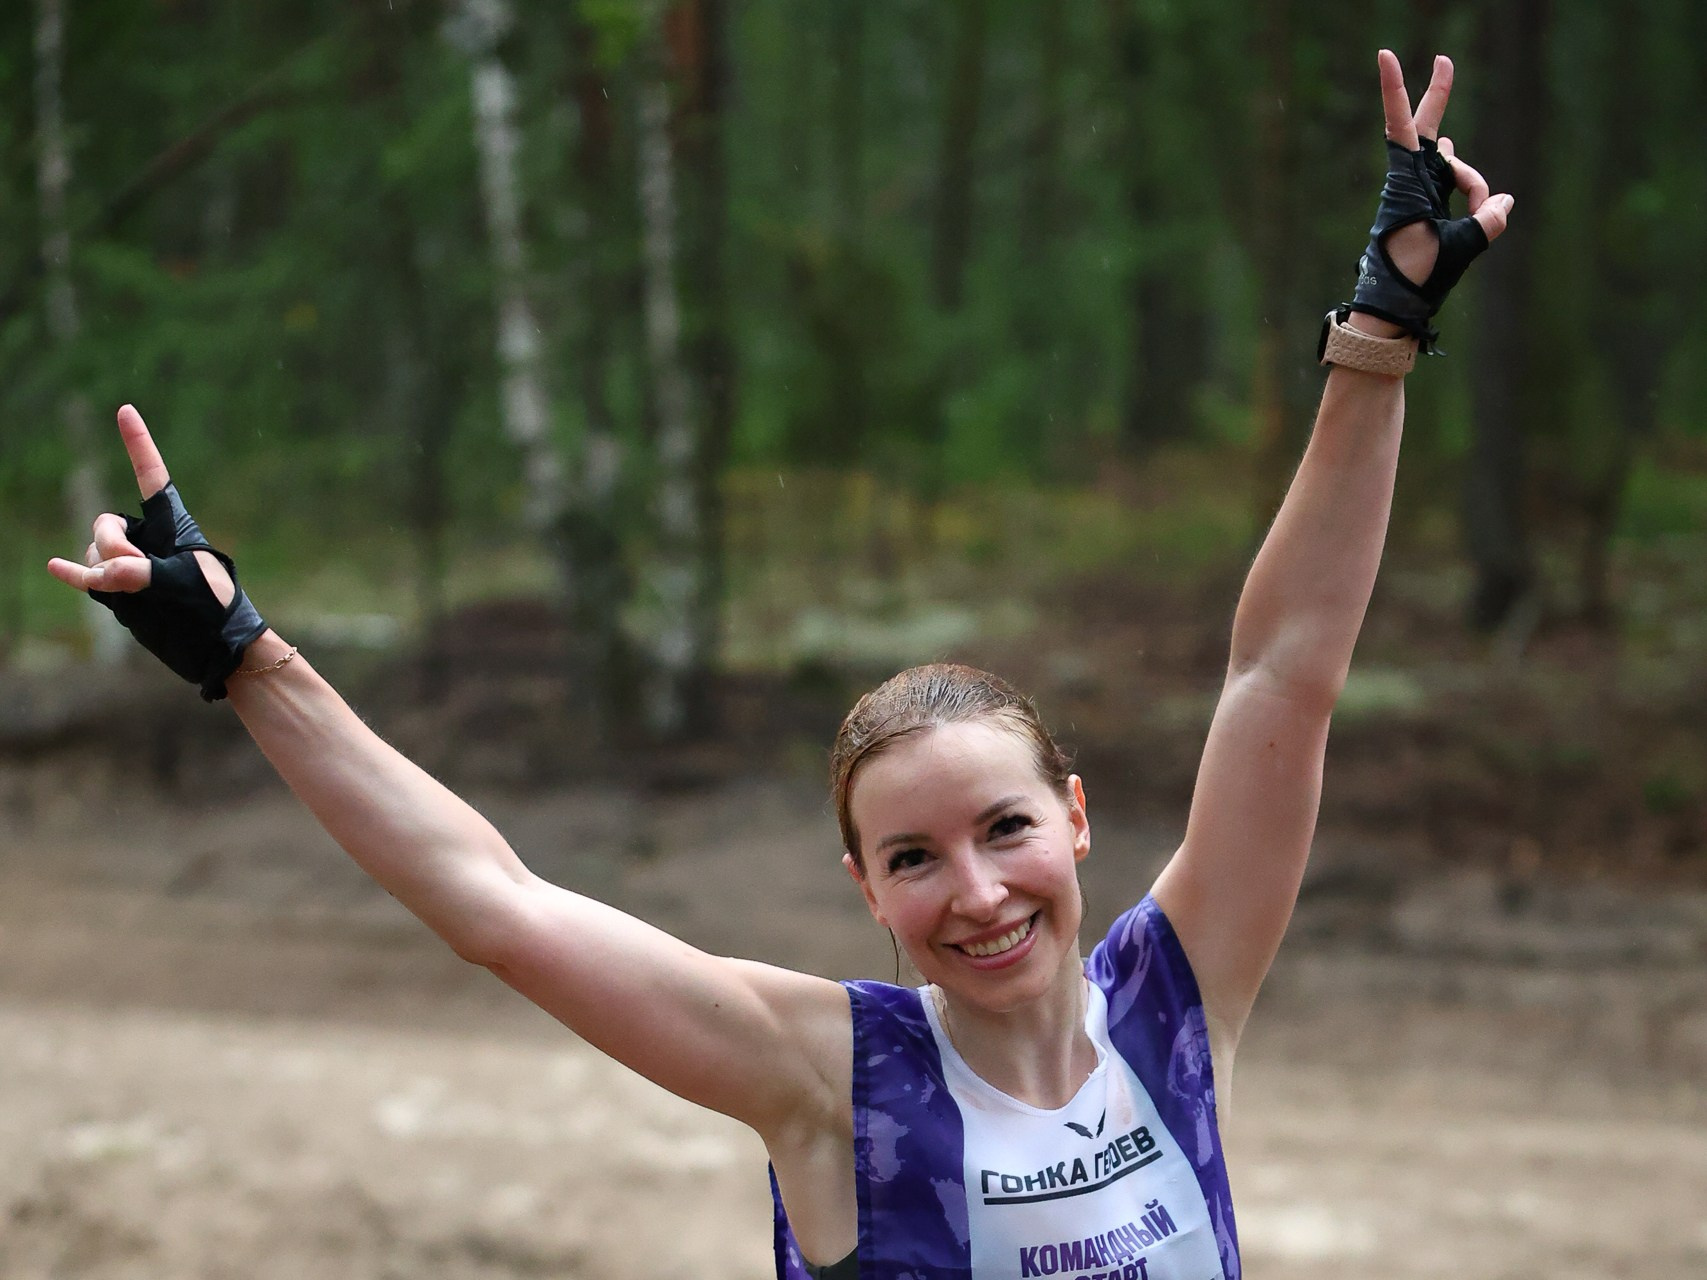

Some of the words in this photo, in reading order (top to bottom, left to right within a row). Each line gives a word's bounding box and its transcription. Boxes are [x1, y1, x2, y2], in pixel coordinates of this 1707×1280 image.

[981, 1157, 1088, 1194] ГОНКА
[1094, 1125, 1156, 1179] ГЕОЕВ
[1020, 1199, 1177, 1278] КОМАНДНЫЙ
